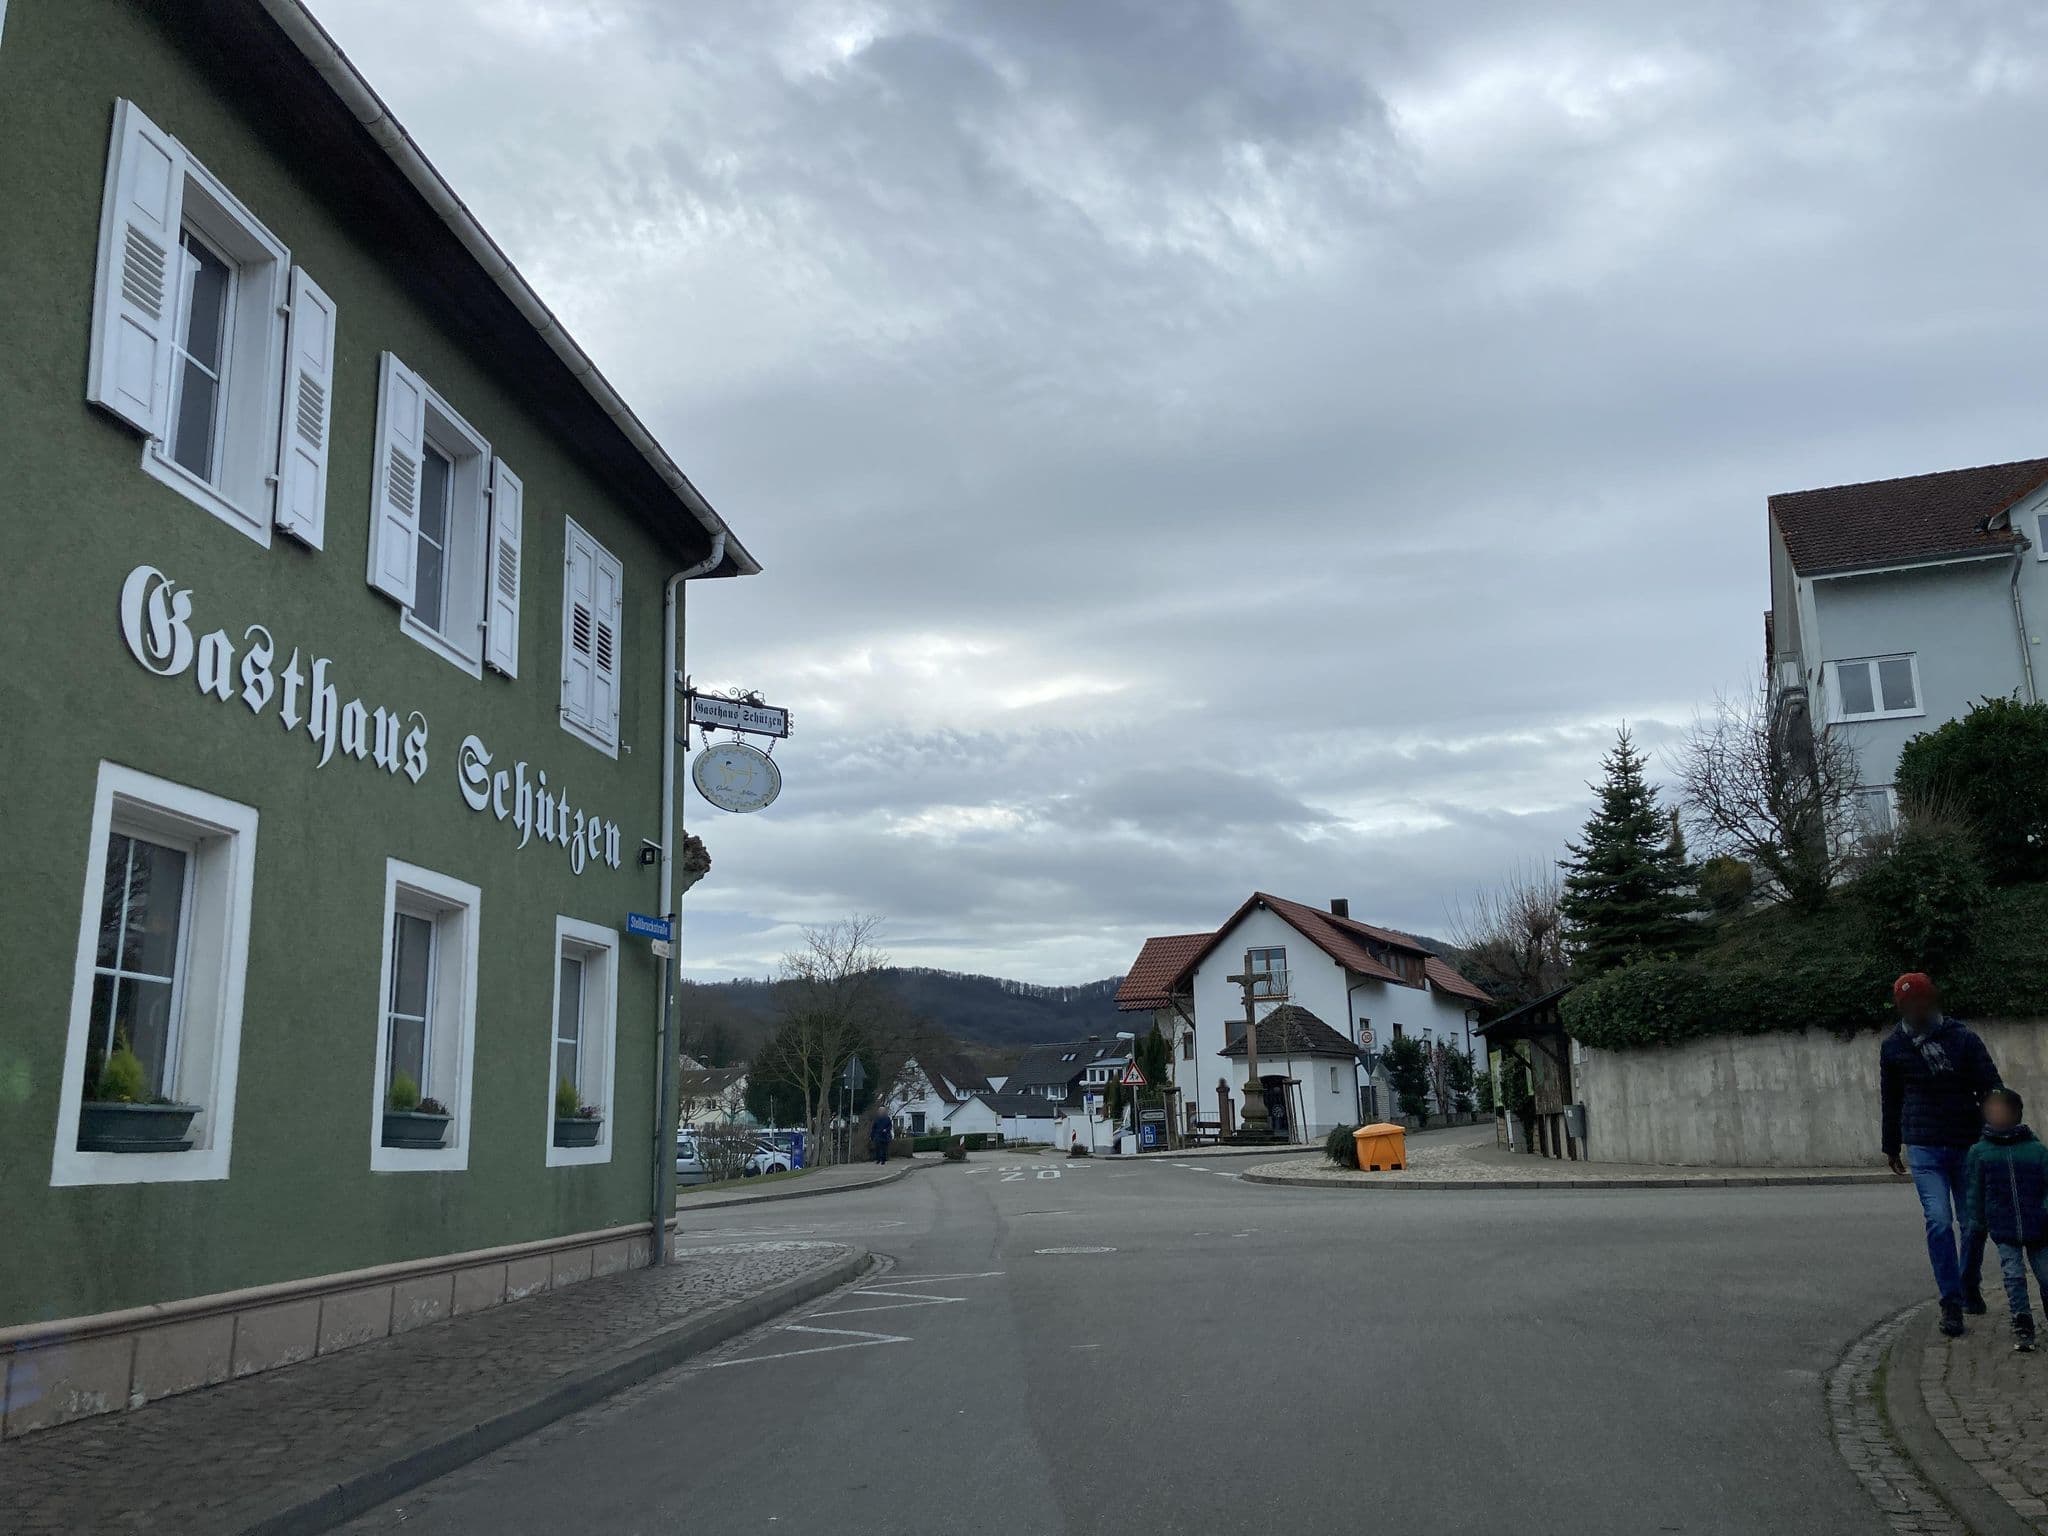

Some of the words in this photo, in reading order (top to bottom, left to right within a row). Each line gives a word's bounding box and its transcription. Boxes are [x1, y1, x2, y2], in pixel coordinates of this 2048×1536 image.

[121, 565, 429, 784] Gasthaus
[695, 702, 739, 720] Gasthaus
[743, 710, 782, 728] Schützen
